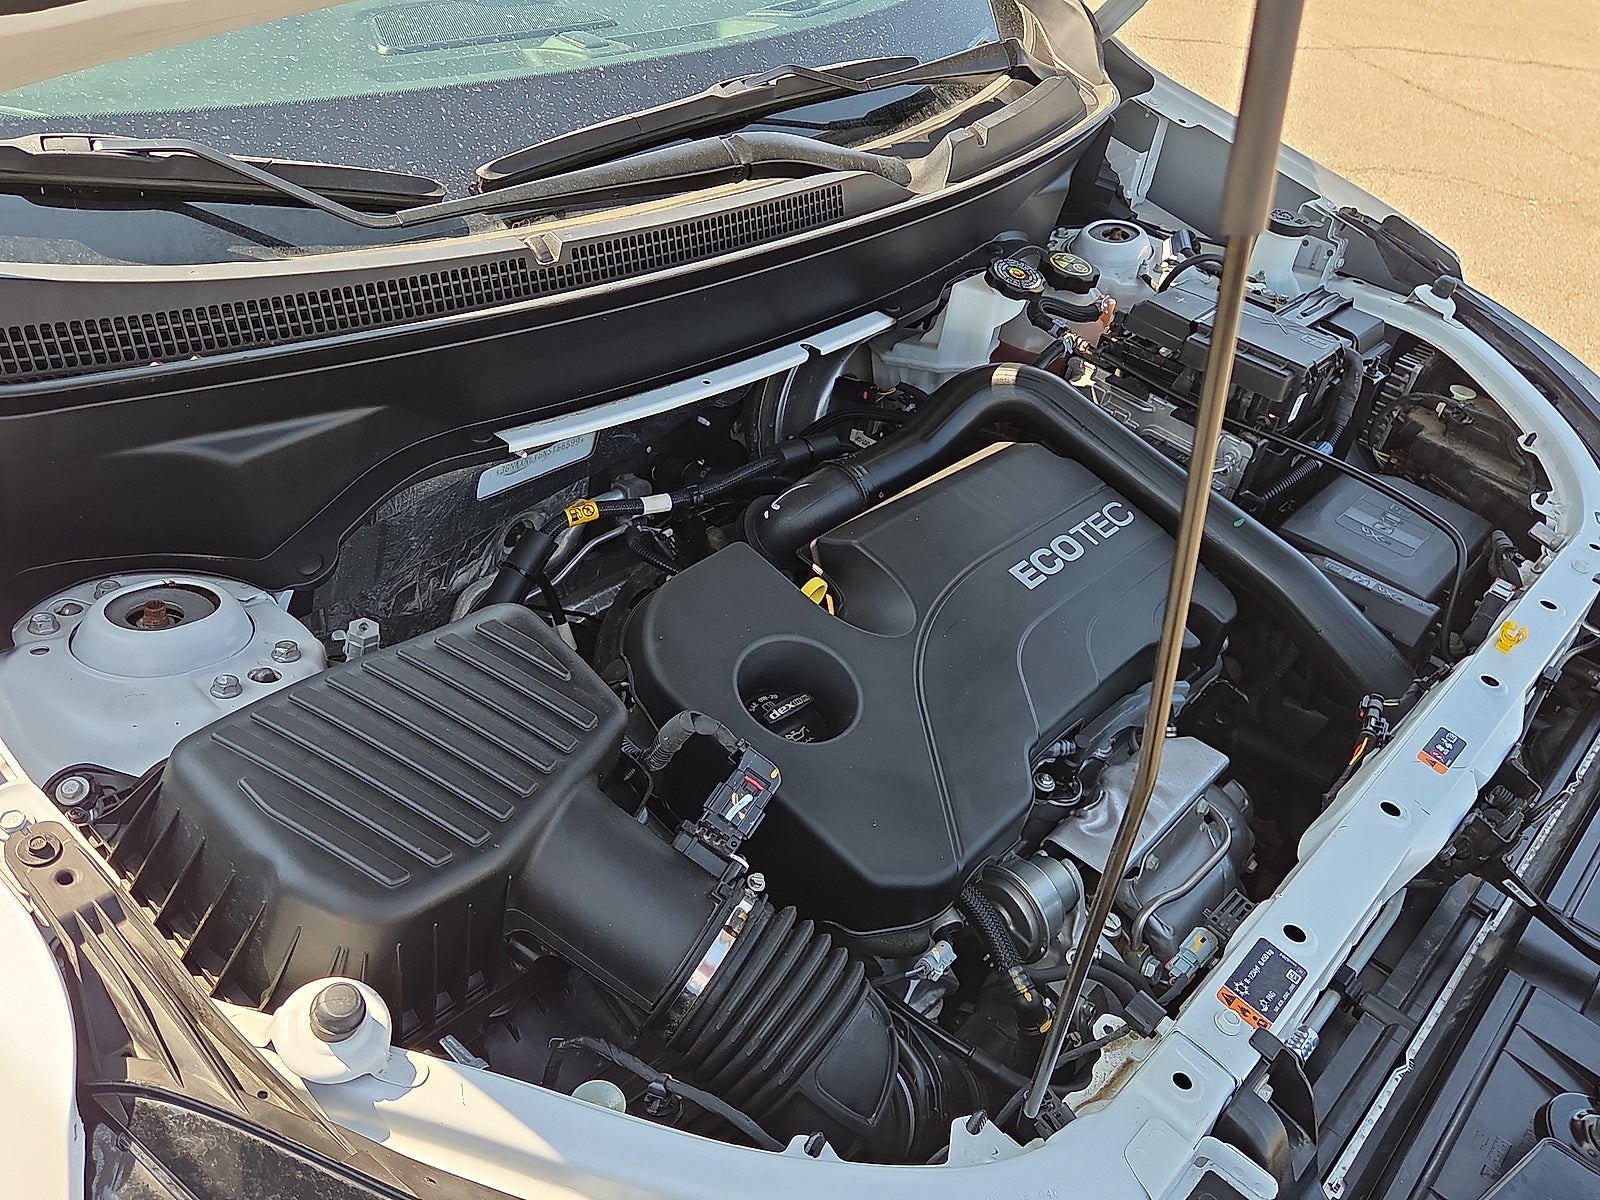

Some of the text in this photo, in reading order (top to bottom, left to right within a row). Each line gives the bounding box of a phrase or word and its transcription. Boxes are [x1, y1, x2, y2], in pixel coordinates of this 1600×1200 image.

[1008, 501, 1135, 590] ECOTEC
[768, 693, 811, 720] dexos
[1265, 990, 1277, 1002] PAG
